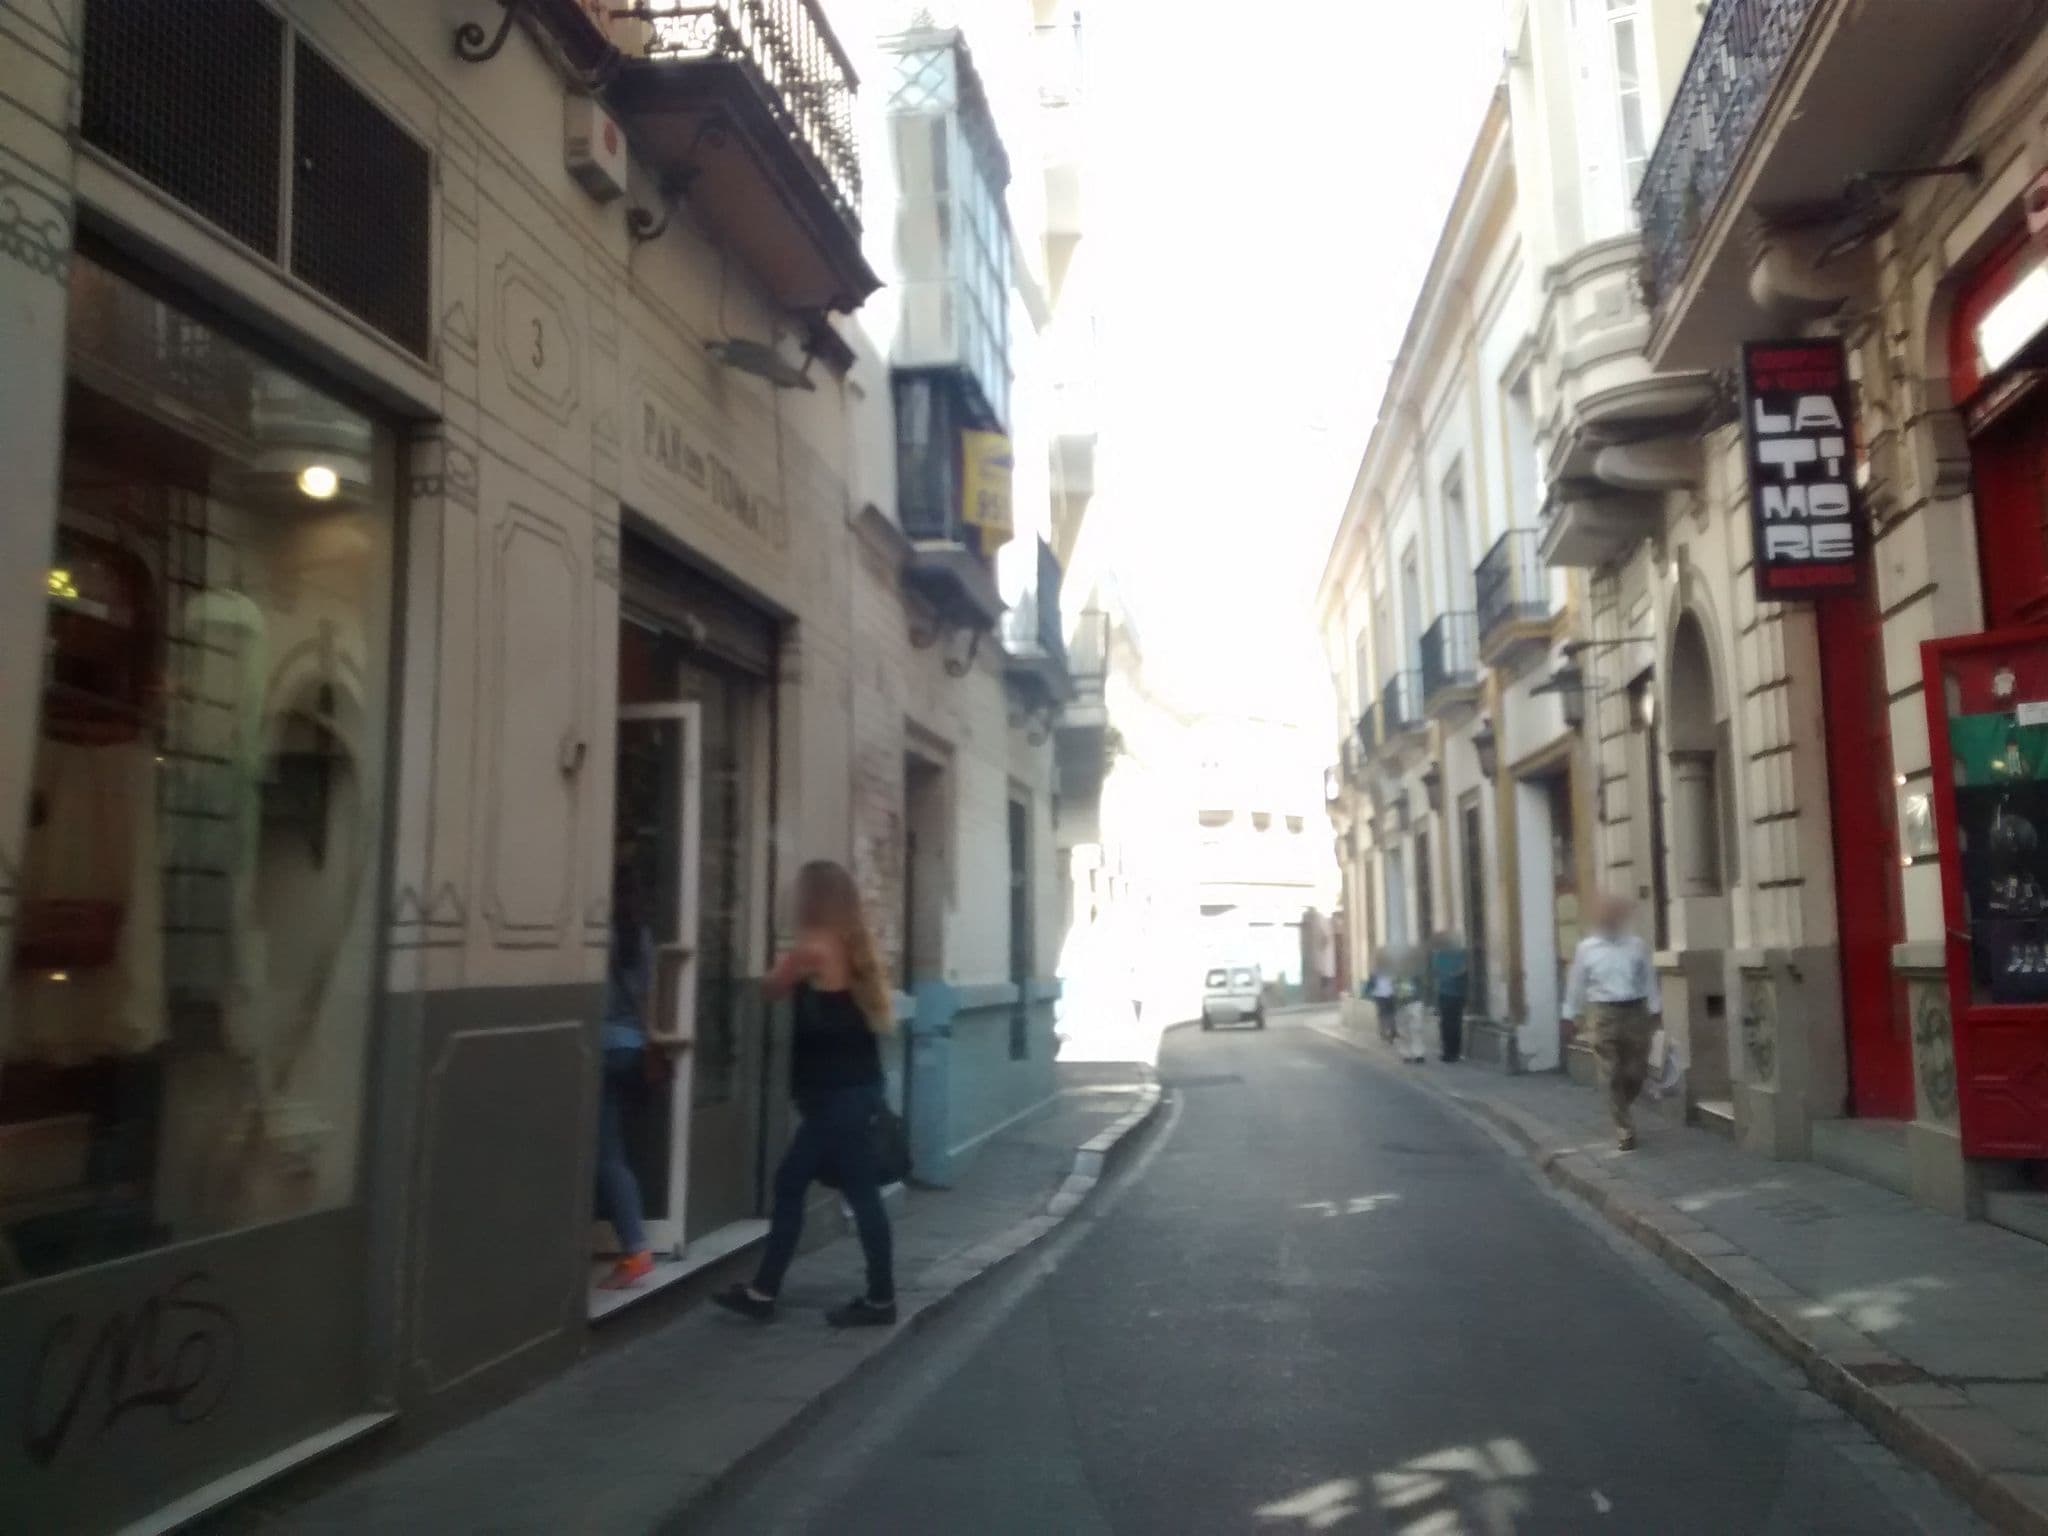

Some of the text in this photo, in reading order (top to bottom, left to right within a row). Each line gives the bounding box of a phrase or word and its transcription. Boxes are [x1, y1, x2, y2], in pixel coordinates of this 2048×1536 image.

[1754, 395, 1843, 433] LA
[1762, 483, 1849, 519] MO
[1766, 523, 1855, 560] RE
